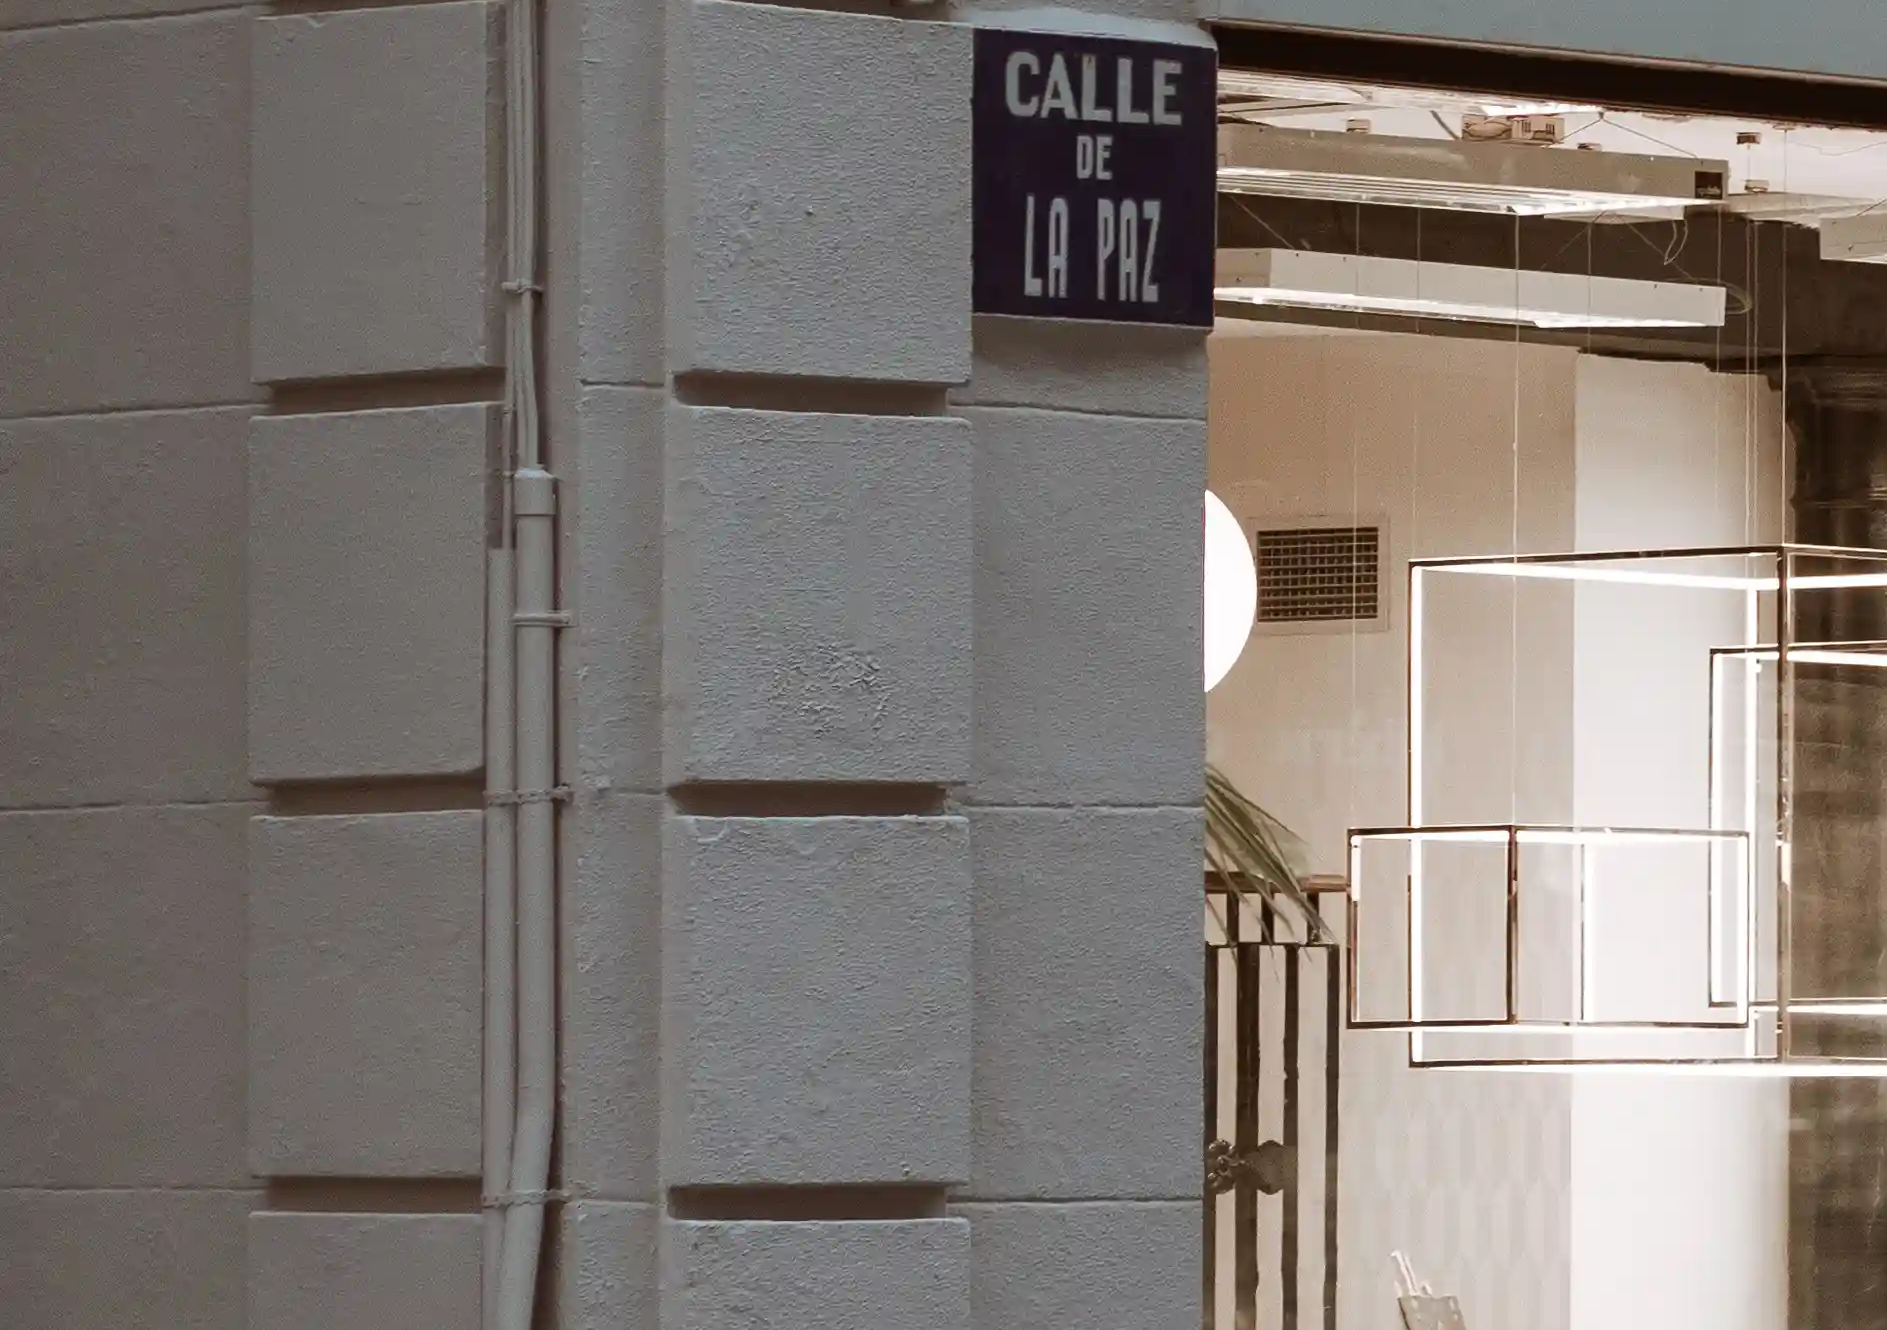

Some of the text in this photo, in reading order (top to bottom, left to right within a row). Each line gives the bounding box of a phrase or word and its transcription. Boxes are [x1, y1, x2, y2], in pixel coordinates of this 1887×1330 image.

[1004, 49, 1183, 126] CALLE
[1076, 134, 1114, 180] DE
[1023, 193, 1161, 303] LA PAZ
